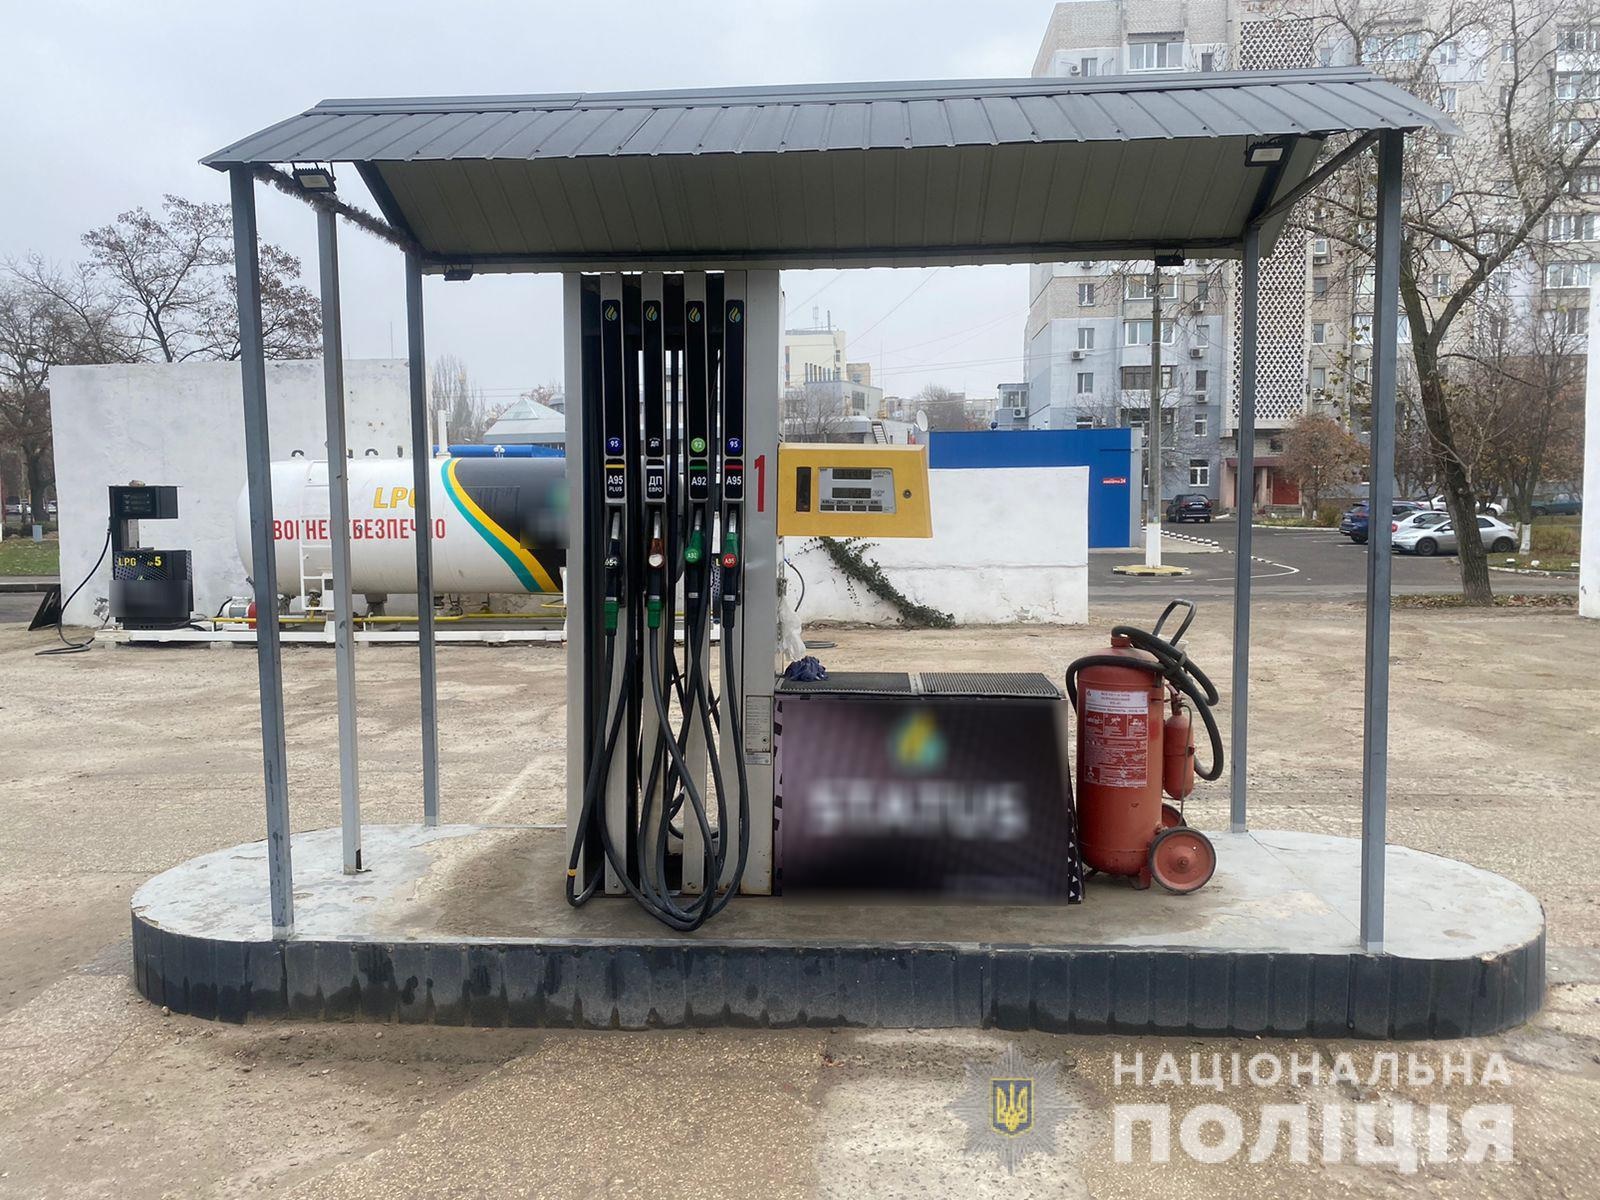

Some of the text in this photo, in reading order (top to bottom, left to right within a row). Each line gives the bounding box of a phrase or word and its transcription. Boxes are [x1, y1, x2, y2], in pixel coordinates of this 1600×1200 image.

[610, 440, 619, 448] 95
[648, 475, 663, 487] ДП
[754, 454, 766, 513] 1
[118, 557, 137, 567] LPG
